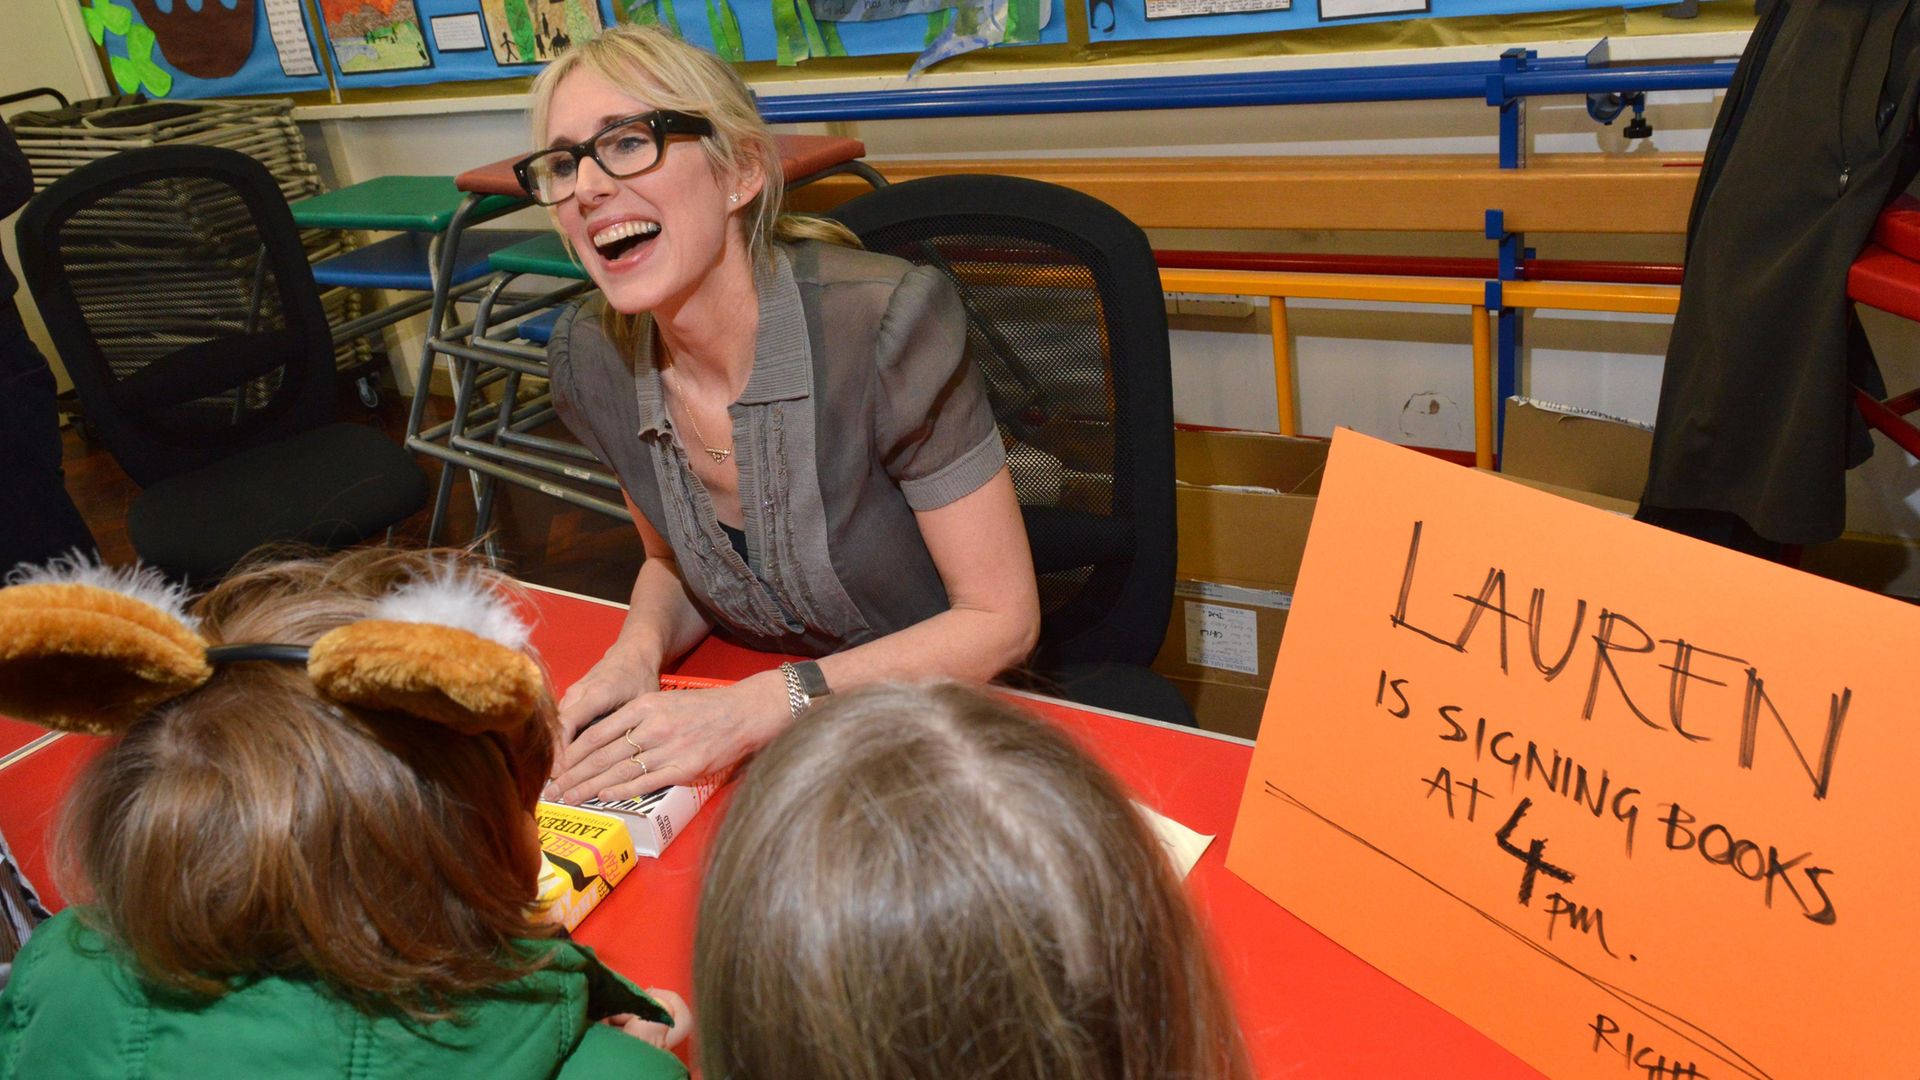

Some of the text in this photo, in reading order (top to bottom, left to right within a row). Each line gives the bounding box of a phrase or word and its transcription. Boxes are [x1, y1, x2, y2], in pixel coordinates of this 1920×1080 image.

[1391, 520, 1853, 800] LAUREN
[663, 815, 674, 841] CHILD
[1376, 670, 1838, 926] IS SIGNING BOOKS
[1421, 766, 1495, 822] AT
